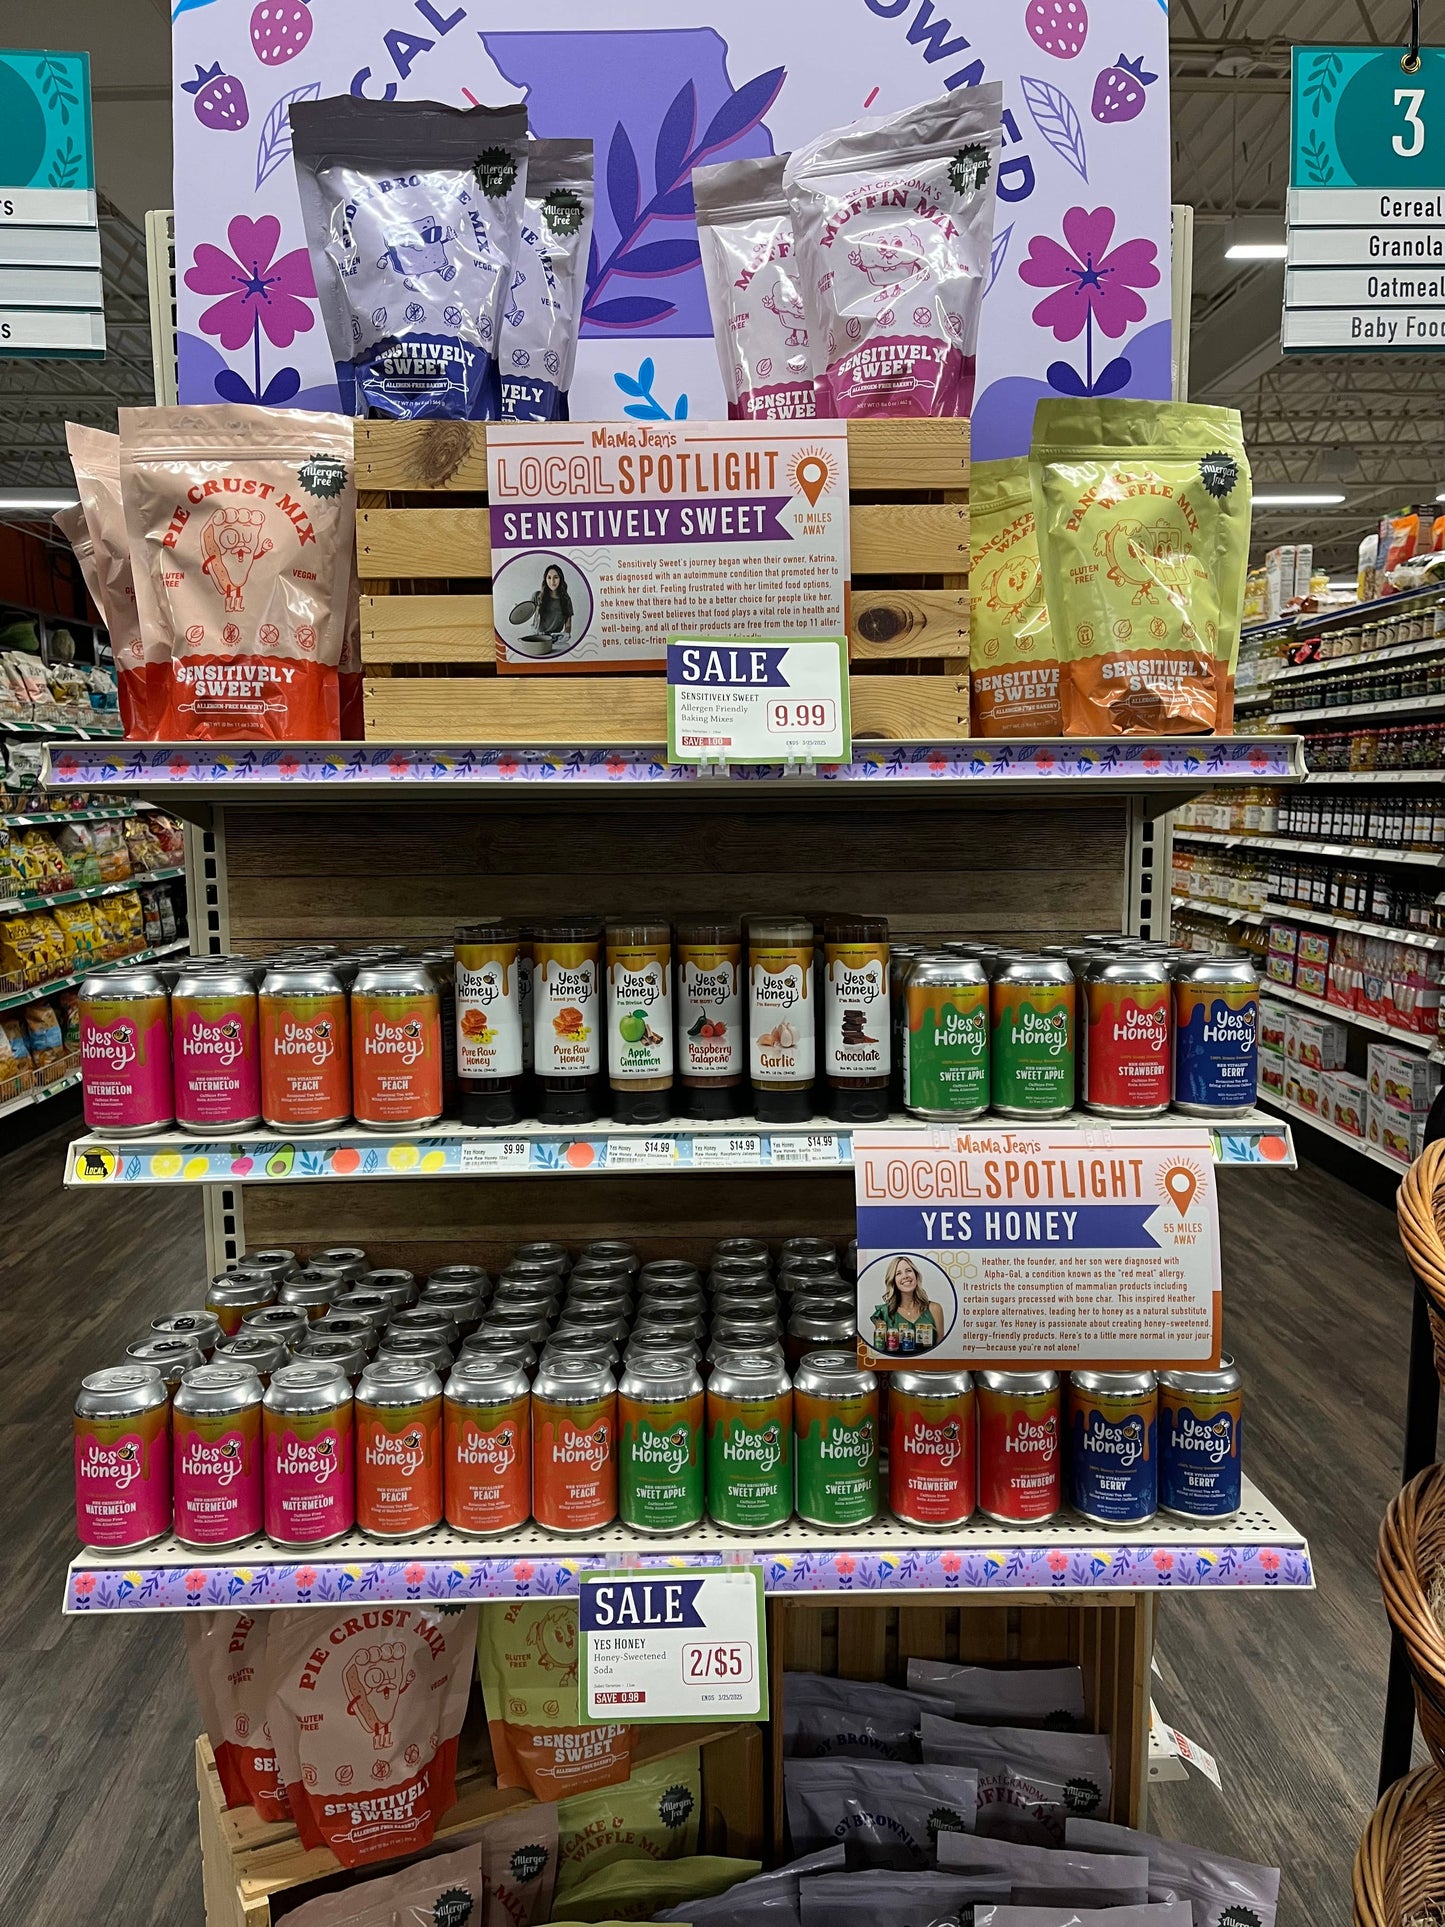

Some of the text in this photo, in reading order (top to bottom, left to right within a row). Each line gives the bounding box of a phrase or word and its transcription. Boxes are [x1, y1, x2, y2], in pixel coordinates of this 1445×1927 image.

[1392, 89, 1425, 157] 3
[477, 164, 513, 177] Allergen
[1380, 196, 1442, 217] Cereal
[820, 190, 960, 248] MUFFIN MIX
[468, 210, 490, 255] MIX
[1369, 236, 1443, 256] Granola
[1368, 277, 1445, 297] Oatmeal
[1352, 317, 1397, 342] Baby
[376, 342, 475, 367] SENSITIVELY
[838, 345, 948, 376] SENSITIVELY
[384, 360, 448, 375] SWEET
[853, 360, 916, 381] SWEET
[591, 427, 678, 449] Mama Jean's
[301, 466, 343, 480] Allergen
[498, 451, 779, 498] LOCAL SPOTLIGHT
[311, 476, 332, 488] free
[162, 478, 317, 549] PIE CRUST MIX
[793, 512, 832, 524] 10 MILES
[1176, 493, 1200, 535] MIX
[503, 505, 767, 541] SENSITIVELY SWEET
[802, 525, 826, 535] AWAY
[618, 560, 656, 569] Sensitively
[659, 559, 687, 568] Sweet's
[689, 558, 716, 568] journey
[719, 557, 740, 567] began
[743, 556, 761, 565] when
[764, 555, 781, 563] their
[292, 569, 317, 581] VEGAN
[616, 572, 652, 582] diagnosed
[655, 572, 670, 580] with
[684, 571, 727, 580] autoimmune
[730, 569, 762, 578] condition
[765, 569, 779, 577] that
[781, 567, 814, 577] promoted
[818, 567, 829, 575] her
[831, 567, 838, 575] to
[1069, 564, 1099, 578] GLUTEN
[1074, 573, 1095, 585] FREE
[176, 665, 296, 684] SENSITIVELY
[682, 650, 768, 683] SALE
[1101, 659, 1208, 680] SENSITIVELY
[195, 681, 264, 697] SWEET
[1129, 675, 1184, 691] SWEET
[681, 691, 759, 702] SENSITIVELY SWEET
[196, 702, 263, 712] ALLERGEN-FREE BAKERY
[681, 703, 748, 713] Allergen Friendly
[681, 714, 733, 724] Baking Mixes
[775, 705, 825, 727] 9.99
[683, 738, 704, 746] SAVE
[559, 972, 579, 985] Yes
[624, 974, 644, 987] Yes
[696, 973, 715, 987] Yes
[550, 983, 592, 1003] Honey
[617, 986, 659, 1006] Honey
[688, 984, 730, 1004] Honey
[1024, 1014, 1051, 1032] Yes
[1126, 1010, 1153, 1027] Yes
[1217, 1011, 1243, 1028] Yes
[193, 1024, 220, 1041] Yes
[285, 1024, 313, 1041] Yes
[1113, 1024, 1167, 1051] Honey
[1204, 1025, 1255, 1052] Honey
[1012, 1028, 1067, 1055] Honey
[183, 1038, 243, 1065] Honey
[275, 1038, 334, 1065] Honey
[554, 1046, 591, 1055] Pure Raw
[628, 1048, 651, 1058] Apple
[689, 1044, 732, 1056] Raspberry
[835, 1050, 880, 1062] Chocolate
[560, 1055, 585, 1064] Honey
[620, 1057, 661, 1067] Cinnamon
[690, 1054, 729, 1066] Jalapeño
[760, 1054, 795, 1068] Garlic
[1016, 1070, 1064, 1080] SWEET APPLE
[1118, 1065, 1165, 1076] STRAWBERRY
[1221, 1067, 1245, 1077] BERRY
[188, 1080, 240, 1091] WATERMELON
[292, 1080, 319, 1091] PEACH
[504, 1144, 525, 1155] $9.99
[644, 1141, 670, 1153] $14.99
[730, 1140, 755, 1151] $14.99
[808, 1136, 832, 1147] $14.99
[957, 1134, 1041, 1154] Mama Jean's
[86, 1166, 104, 1175] LOCAL
[865, 1159, 1143, 1199] LOCAL SPOTLIGHT
[921, 1211, 1078, 1241] YES HONEY
[1163, 1223, 1203, 1233] 55 MILES
[1173, 1235, 1197, 1245] AWAY
[1059, 1257, 1072, 1265] and
[1075, 1257, 1086, 1265] her
[1125, 1257, 1161, 1267] diagnosed
[1164, 1257, 1179, 1265] with
[1094, 1421, 1123, 1440] Yes
[375, 1434, 402, 1452] Yes
[642, 1431, 669, 1450] Yes
[287, 1442, 316, 1461] Yes
[632, 1444, 689, 1473] Honey
[1083, 1436, 1142, 1466] Honey
[366, 1447, 424, 1476] Honey
[277, 1456, 337, 1484] Honey
[636, 1487, 686, 1499] SWEET APPLE
[1100, 1479, 1127, 1492] BERRY
[282, 1496, 334, 1511] WATERMELON
[381, 1490, 407, 1501] PEACH
[595, 1586, 683, 1625] SALE
[300, 1609, 446, 1691] PIE CRUST MIX
[594, 1638, 646, 1650] YES HONEY
[594, 1652, 667, 1663] Honey-Sweetened
[691, 1647, 742, 1677] 2/$5
[594, 1666, 613, 1674] Soda
[596, 1693, 638, 1703] SAVE 0.98
[324, 1771, 430, 1816] SENSITIVELY
[351, 1801, 415, 1825] SWEET
